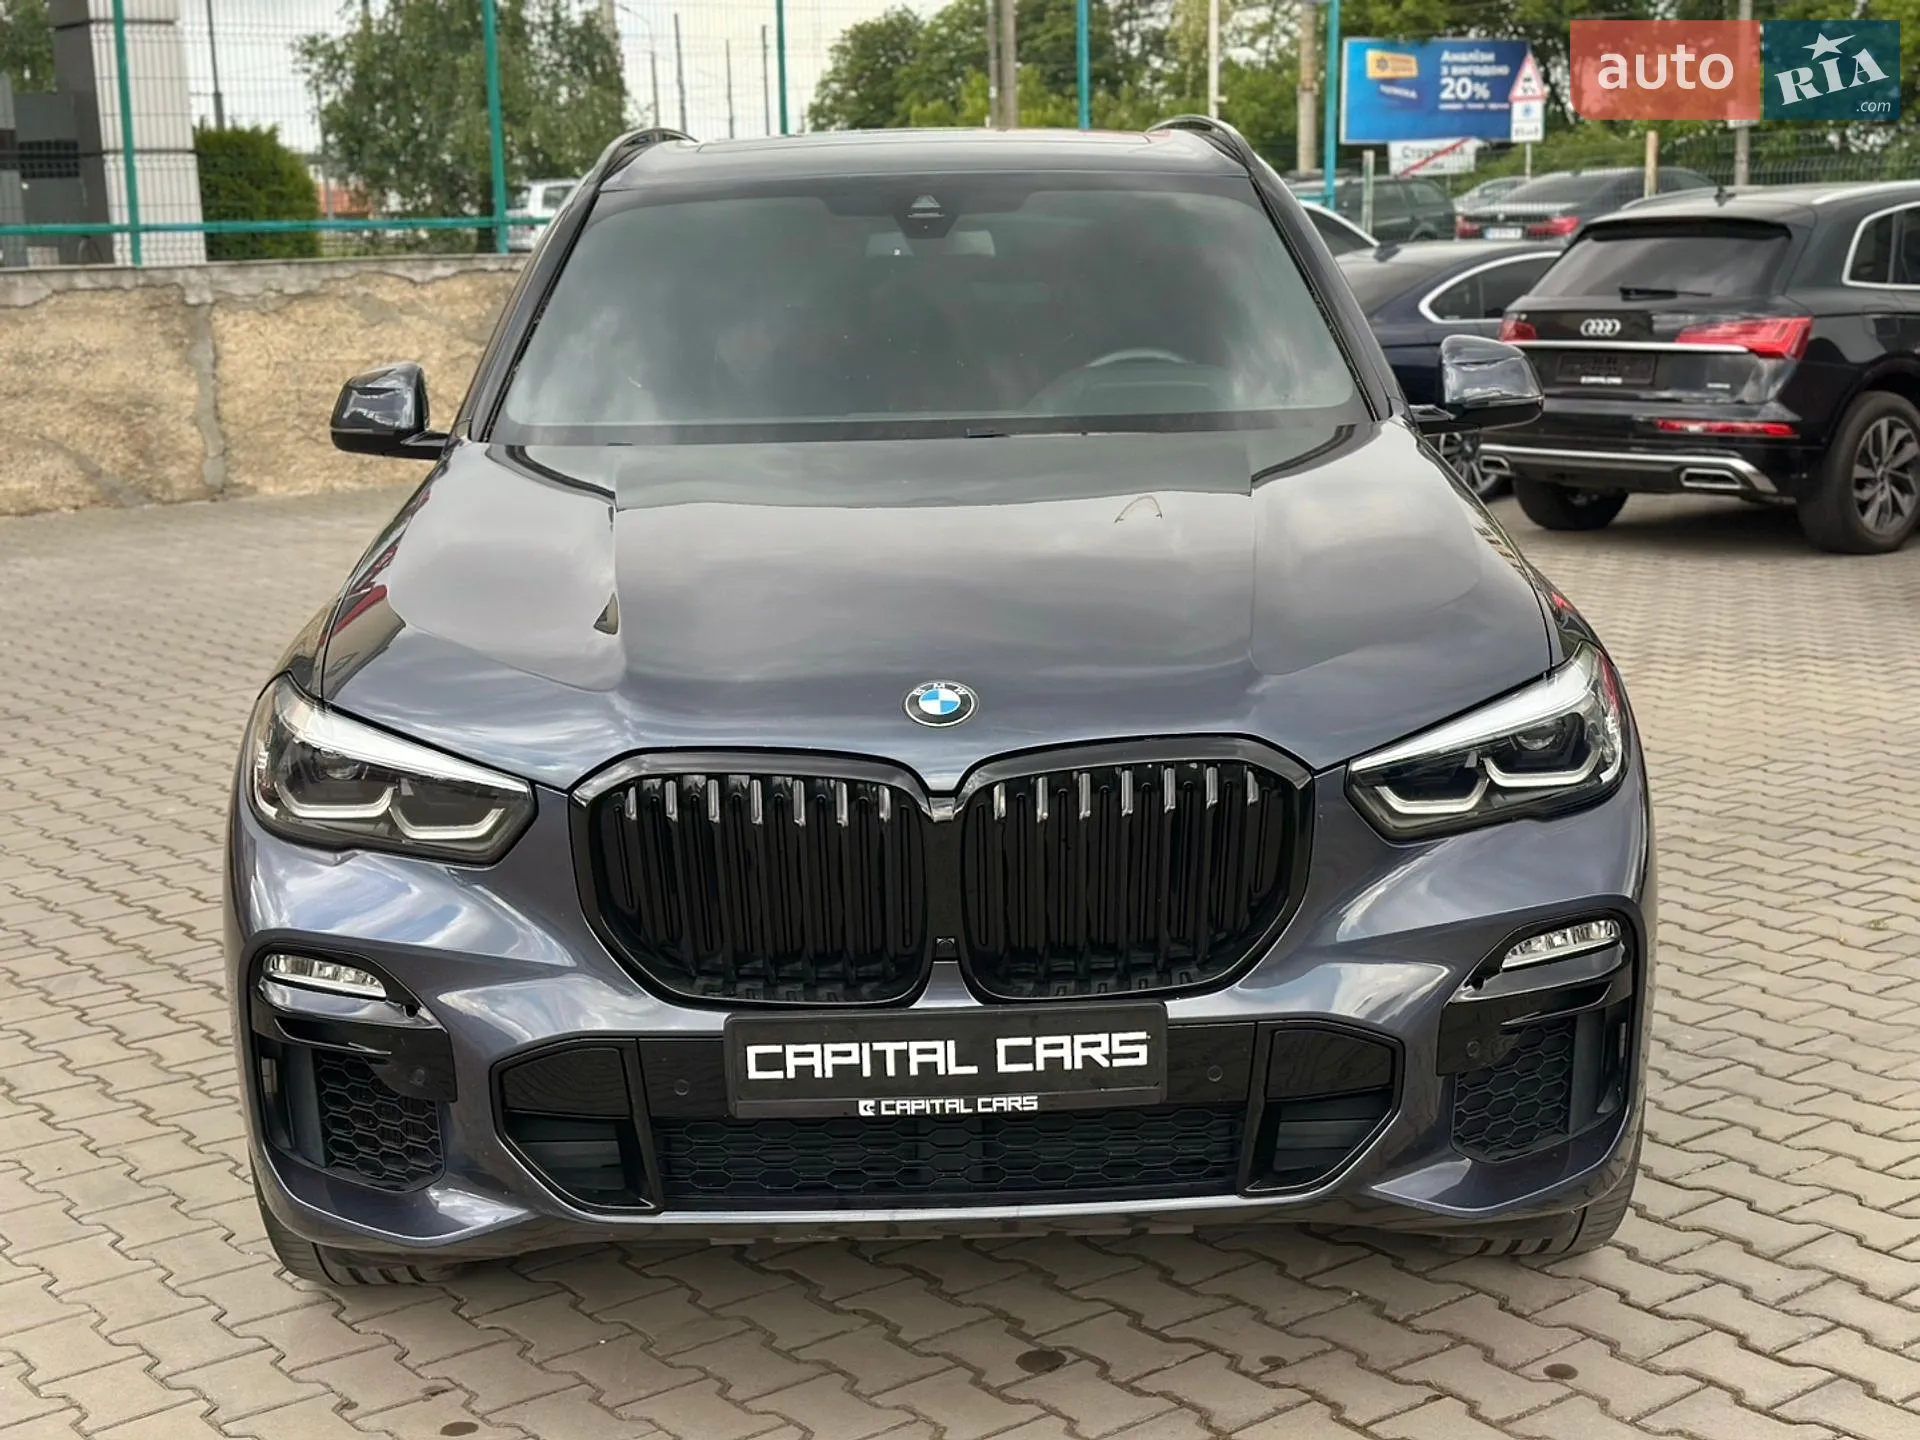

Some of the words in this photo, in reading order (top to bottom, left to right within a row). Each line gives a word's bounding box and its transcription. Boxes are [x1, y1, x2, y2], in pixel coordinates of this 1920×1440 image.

[1440, 77, 1490, 100] 20%
[913, 682, 969, 695] BMW
[746, 1040, 979, 1080] CAPITAL
[996, 1031, 1148, 1074] CARS
[881, 1098, 973, 1115] CAPITAL
[977, 1096, 1038, 1113] CARS
